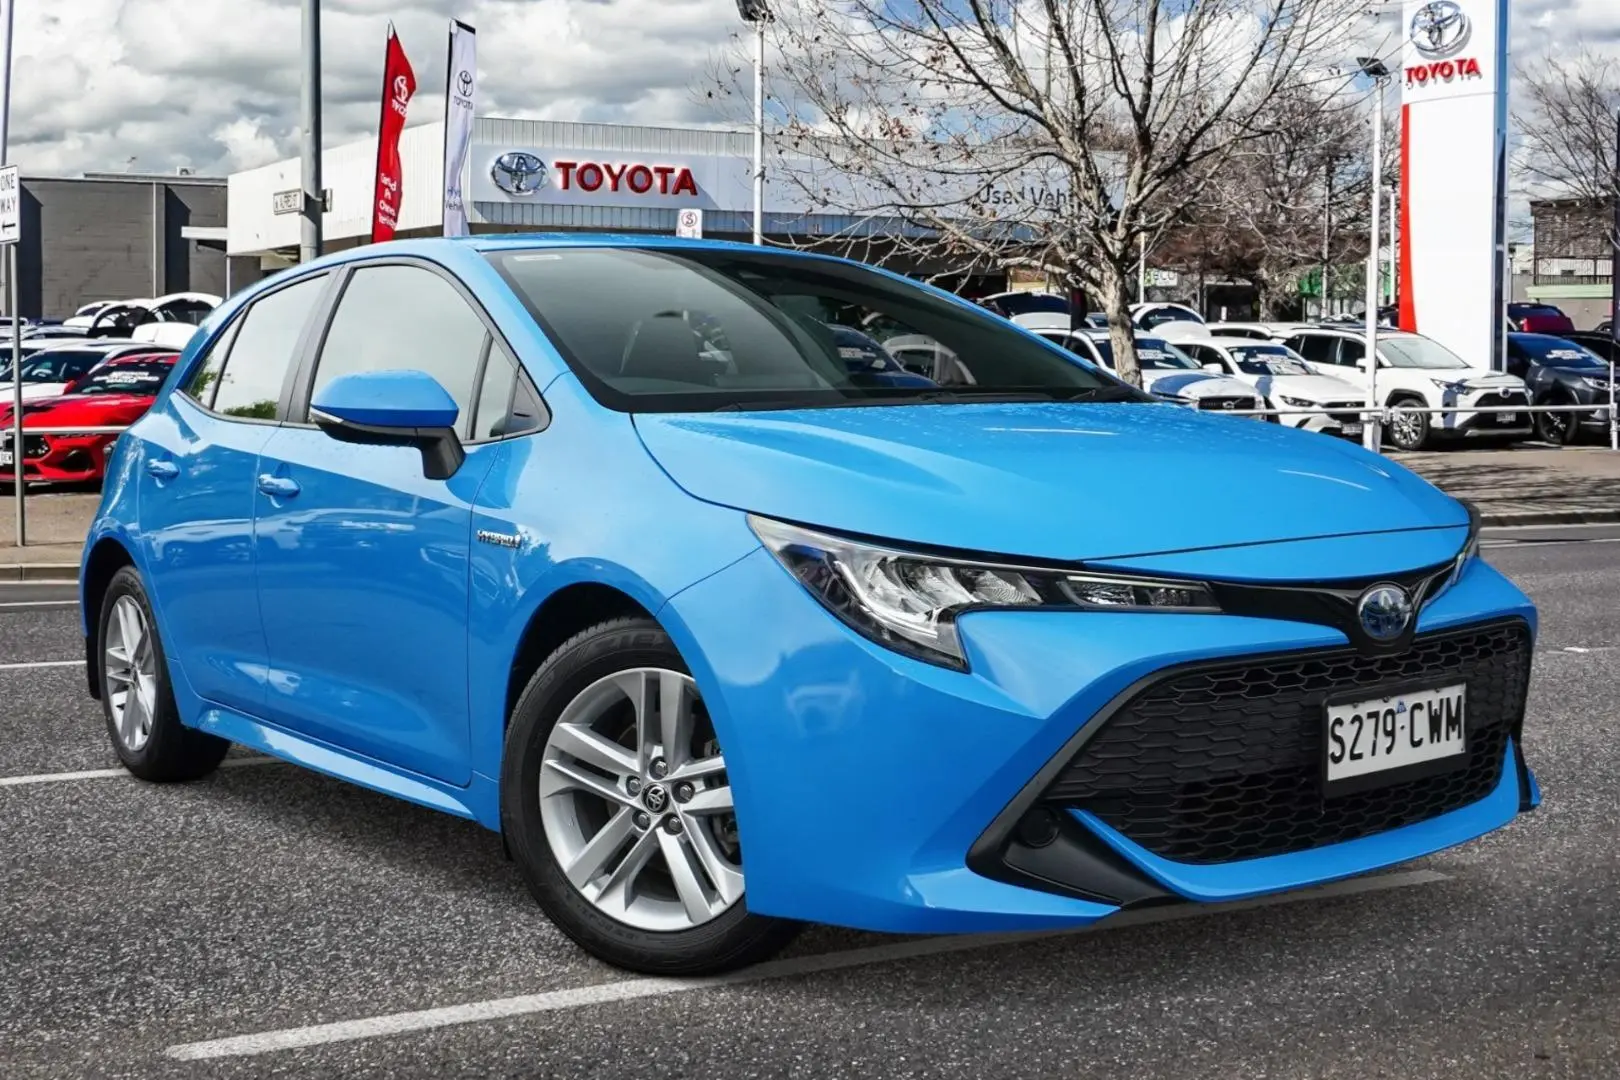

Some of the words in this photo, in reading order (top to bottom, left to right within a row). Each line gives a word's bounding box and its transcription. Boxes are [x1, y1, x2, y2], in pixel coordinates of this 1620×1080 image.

[1404, 58, 1481, 83] TOYOTA
[1, 173, 15, 191] ONE
[554, 161, 698, 196] TOYOTA
[1, 195, 16, 214] WAY
